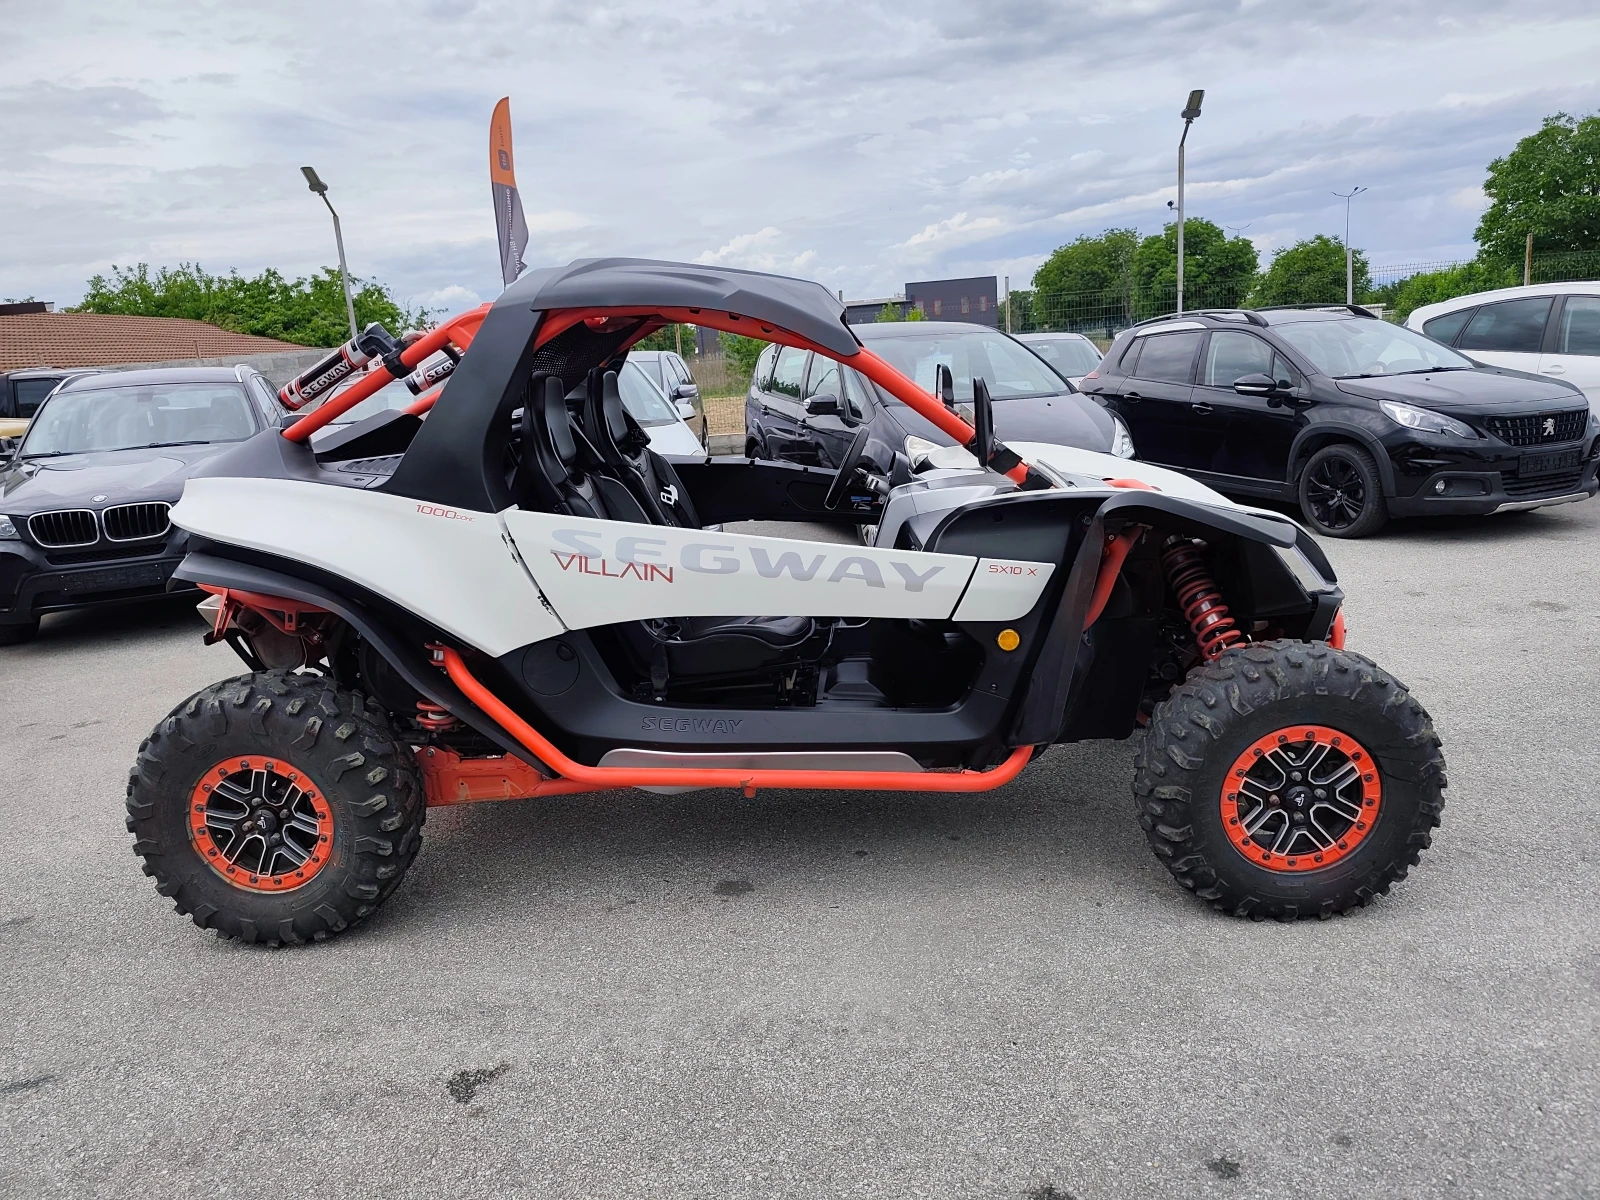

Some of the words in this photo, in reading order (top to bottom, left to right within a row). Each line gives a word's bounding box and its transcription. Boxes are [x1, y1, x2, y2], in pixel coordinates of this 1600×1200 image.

[301, 360, 351, 398] SEGWAY
[416, 504, 457, 519] 1000
[550, 528, 946, 592] SEGWAY
[552, 551, 674, 583] VILLAIN
[988, 564, 1023, 576] SX10
[1026, 567, 1039, 577] X
[641, 716, 743, 734] SEGWAY
